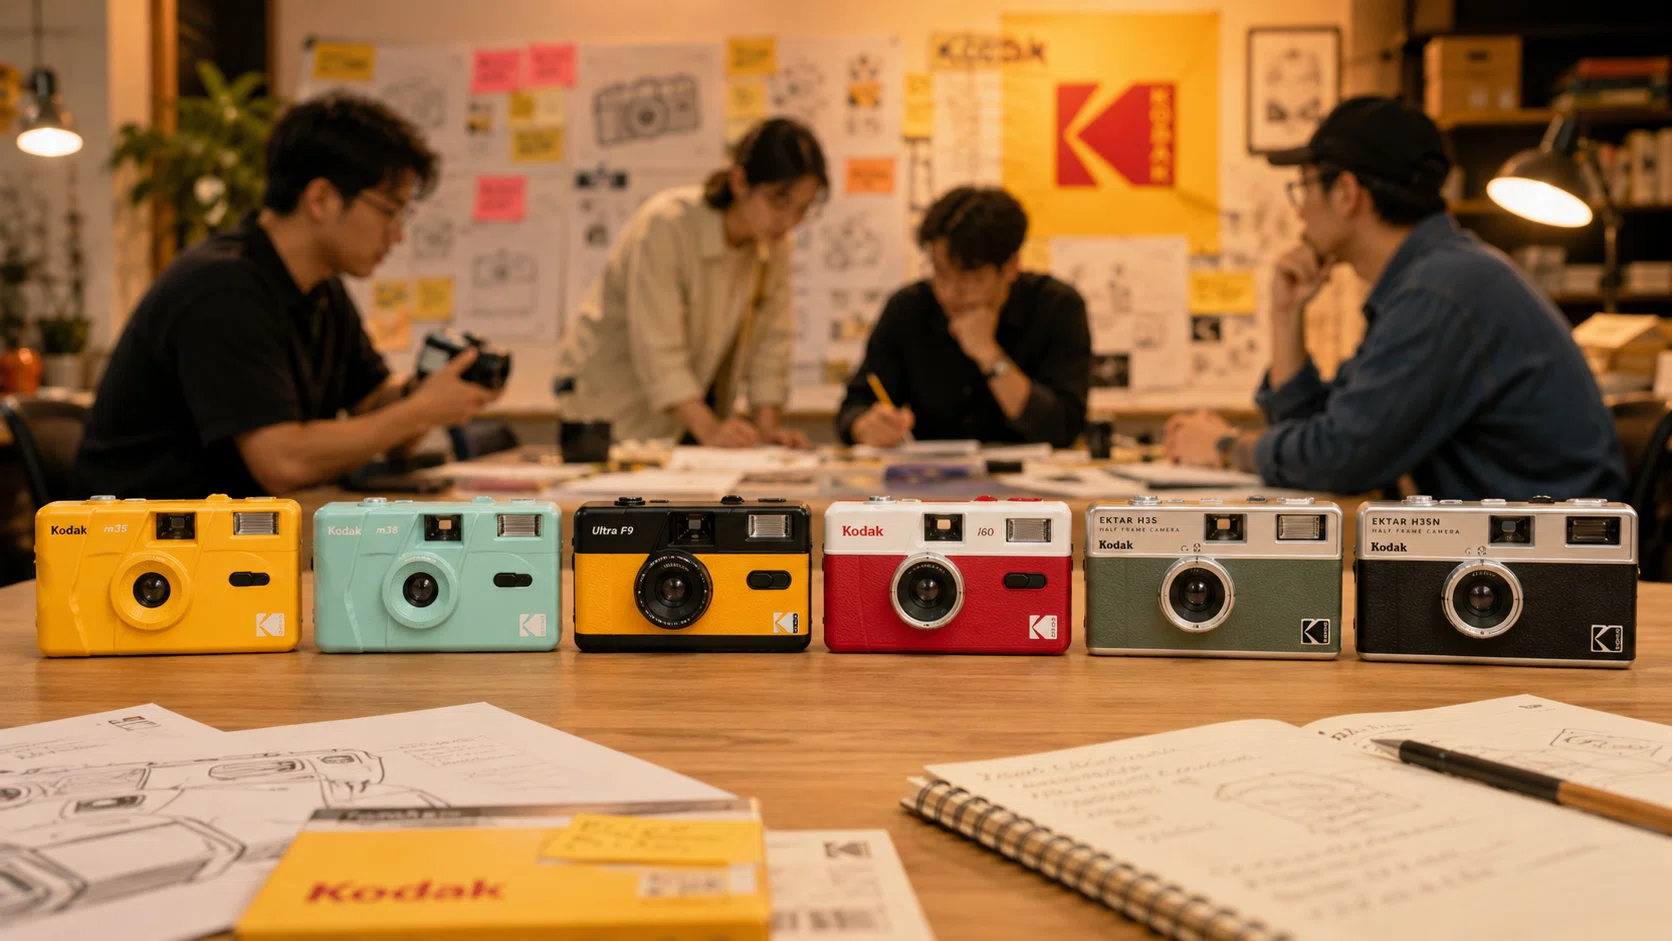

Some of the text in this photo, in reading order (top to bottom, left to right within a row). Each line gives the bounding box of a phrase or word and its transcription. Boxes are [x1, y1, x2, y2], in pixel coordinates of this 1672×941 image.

[1099, 516, 1133, 524] EKTAR
[1371, 517, 1407, 526] EKTAR
[51, 525, 87, 535] Kodak
[328, 526, 362, 536] Kodak
[592, 526, 634, 536] Ultra F9
[842, 525, 884, 537] Kodak
[1098, 540, 1134, 550] Kodak
[1370, 542, 1408, 552] Kodak
[305, 877, 507, 905] Kodak
